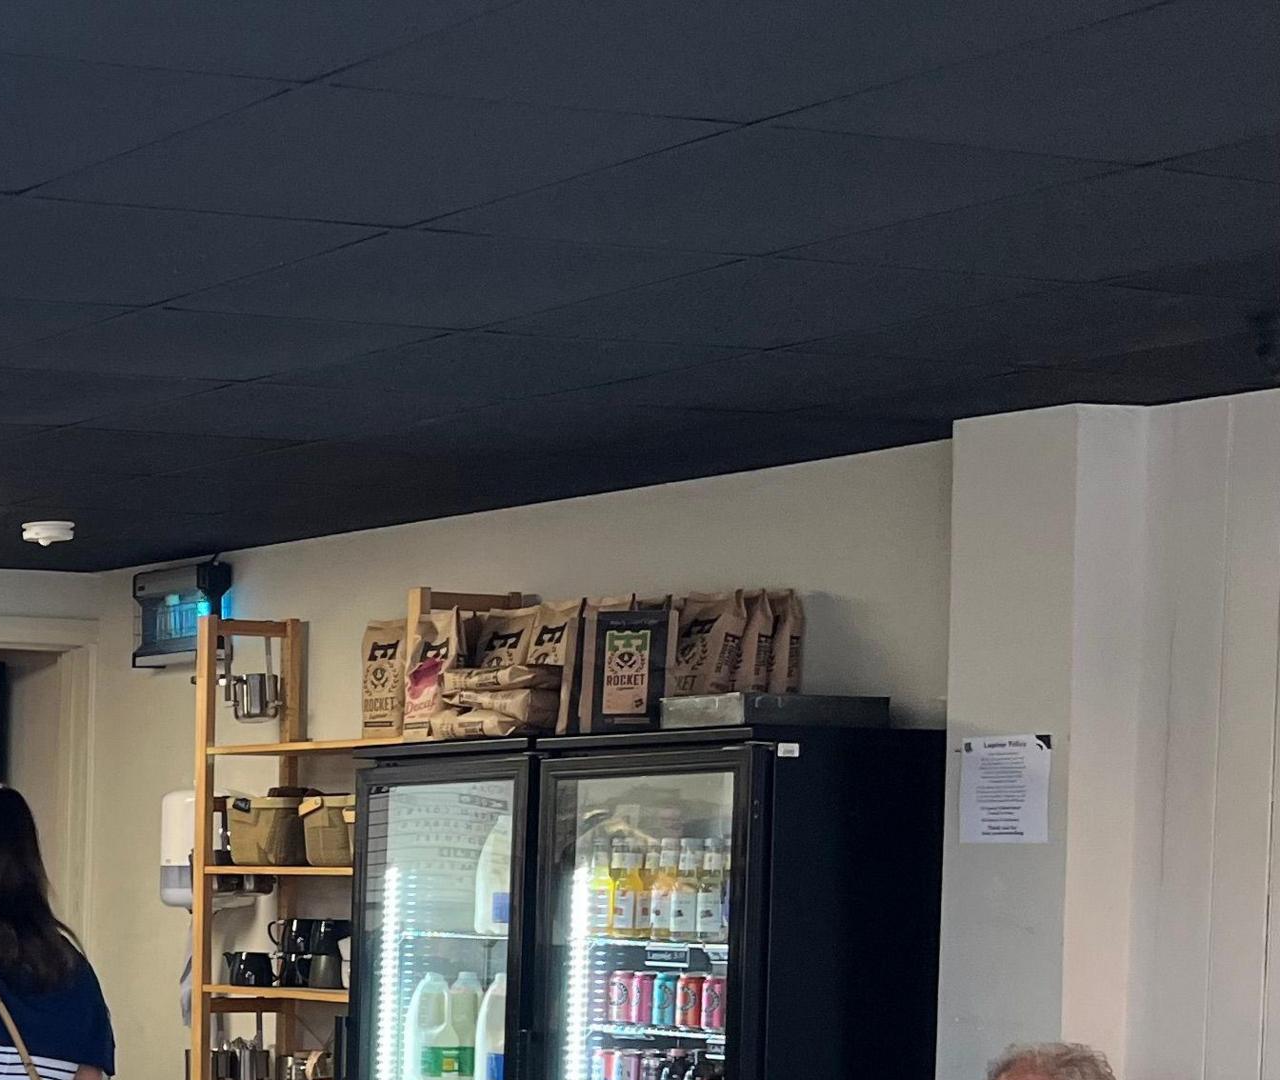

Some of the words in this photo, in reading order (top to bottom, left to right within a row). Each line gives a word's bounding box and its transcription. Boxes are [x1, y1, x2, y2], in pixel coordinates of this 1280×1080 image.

[606, 673, 646, 687] ROCKET
[674, 675, 697, 689] KET
[364, 696, 396, 713] ROCKET
